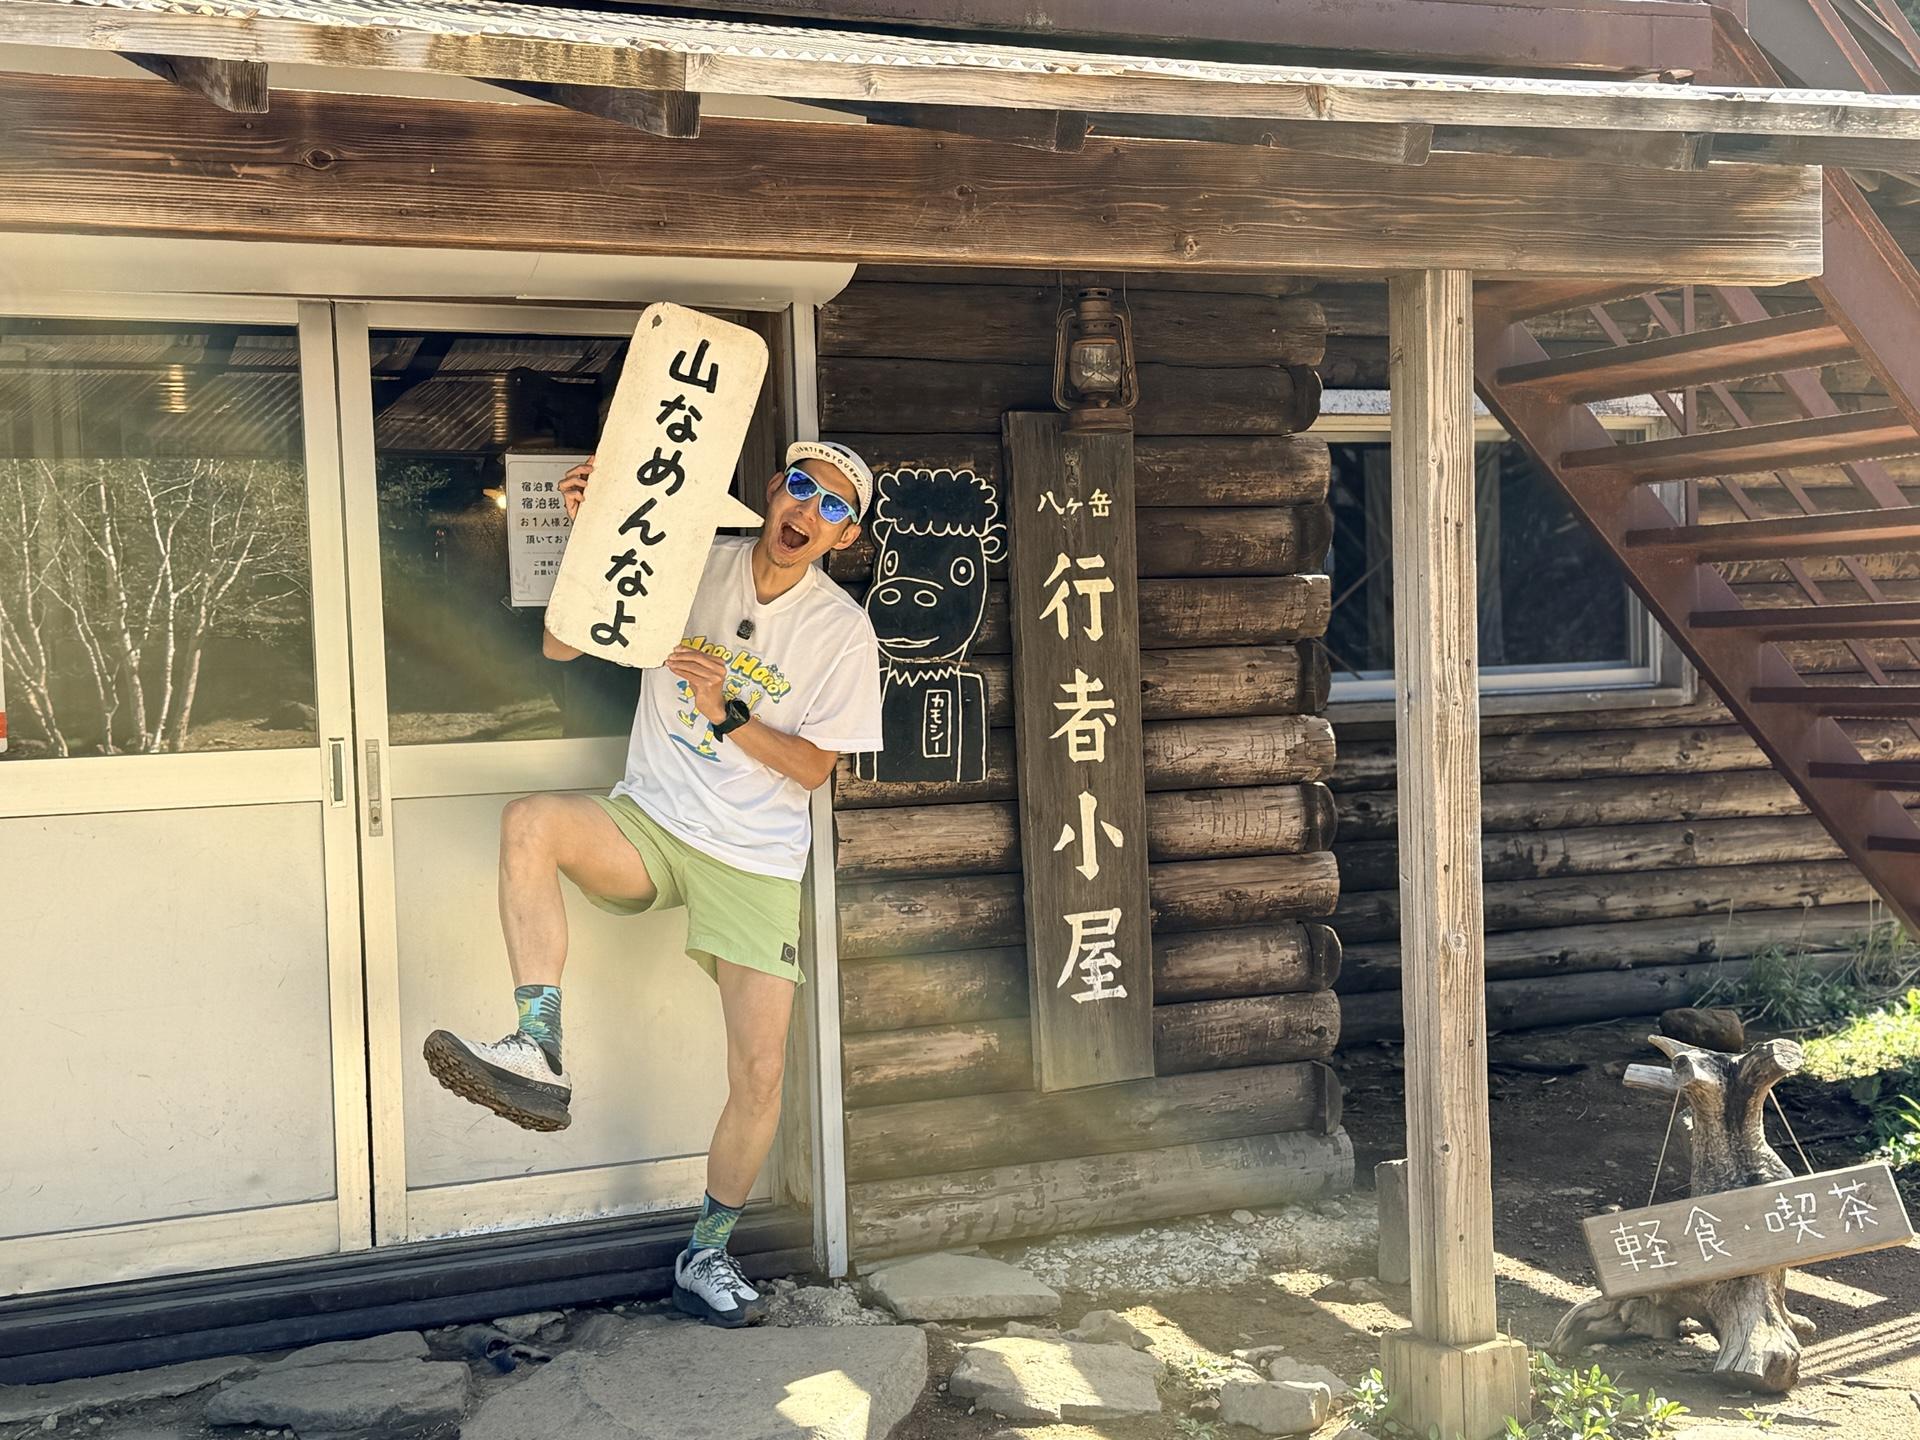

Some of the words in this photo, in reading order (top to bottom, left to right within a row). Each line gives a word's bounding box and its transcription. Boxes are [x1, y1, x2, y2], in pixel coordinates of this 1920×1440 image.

[521, 482, 561, 491] 宿泊費
[522, 498, 565, 509] 宿泊税
[590, 338, 719, 648] 山なめんなよ
[521, 518, 573, 527] お1人様2
[929, 694, 944, 753] カモシー
[1039, 552, 1127, 1004] 行者小屋
